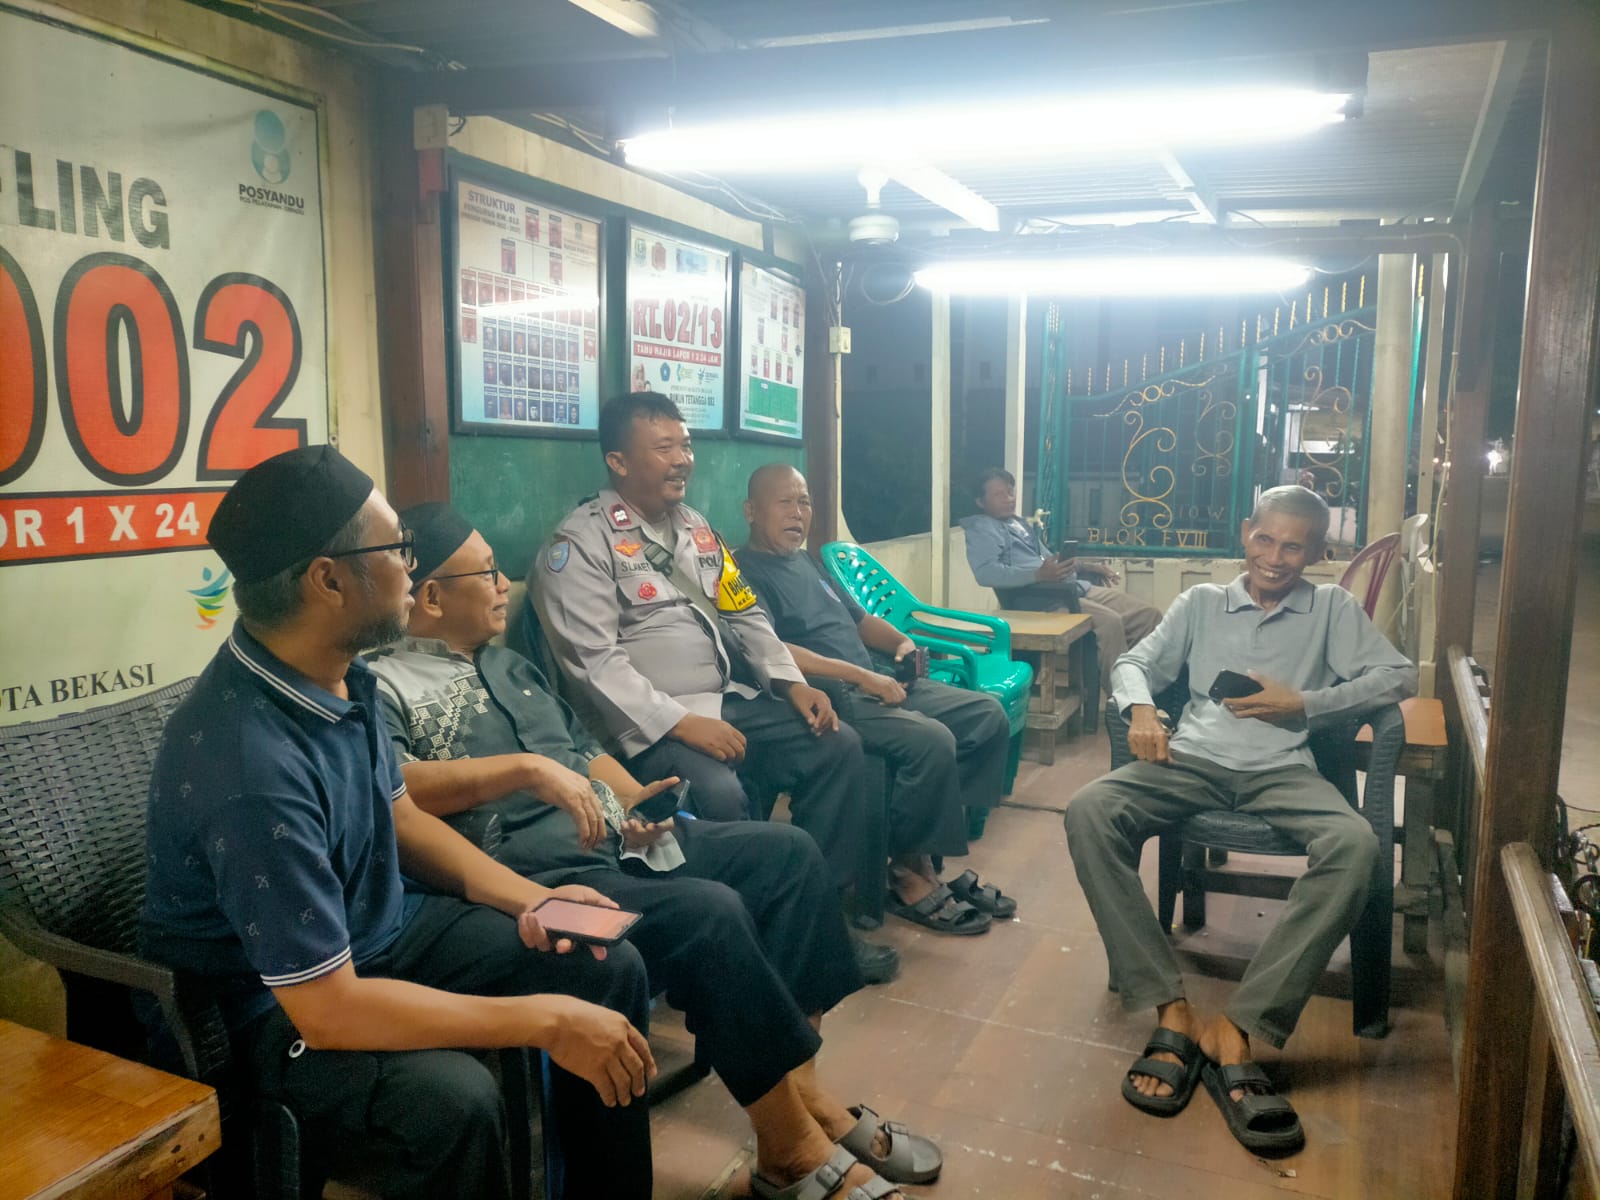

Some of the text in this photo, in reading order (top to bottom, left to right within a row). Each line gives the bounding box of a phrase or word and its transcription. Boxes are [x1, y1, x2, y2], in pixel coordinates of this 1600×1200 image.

[0, 149, 170, 250] LING
[239, 184, 304, 209] POSYANDU
[469, 191, 516, 215] STRUKTUR
[0, 502, 200, 548] R 1 X 24
[1087, 527, 1147, 546] BLOK
[0, 663, 155, 712] TA BEKASI
